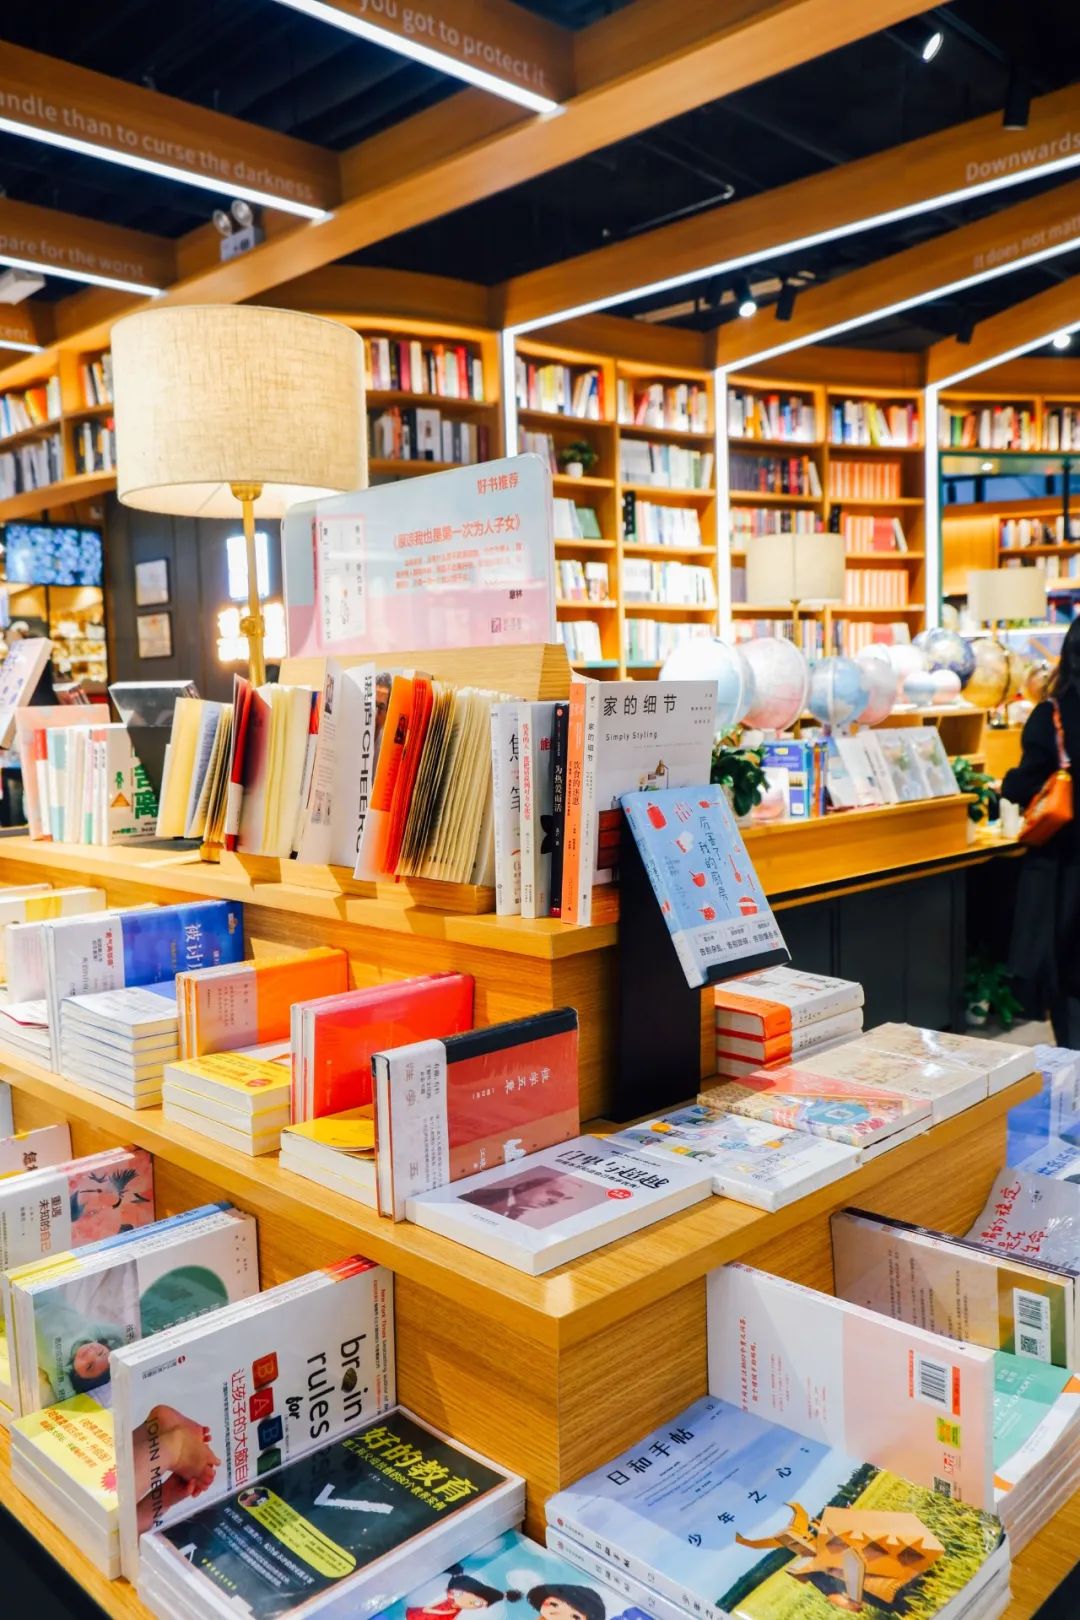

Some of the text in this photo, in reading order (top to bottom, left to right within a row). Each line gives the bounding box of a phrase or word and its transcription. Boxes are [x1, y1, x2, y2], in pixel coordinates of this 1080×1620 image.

[360, 0, 546, 87] you got to protect it
[62, 107, 112, 140] than
[116, 125, 139, 147] to
[142, 134, 197, 164] curse
[199, 151, 230, 176] the
[233, 161, 314, 201] darkness
[964, 130, 1080, 183] Downwards
[40, 239, 63, 259] for
[69, 246, 96, 266] the
[99, 257, 144, 277] worst
[986, 240, 1019, 266] does
[1021, 229, 1046, 250] not
[477, 471, 519, 495] 好书推荐
[603, 694, 677, 717] 家的细节
[605, 730, 658, 743] Simply Styling
[285, 1396, 303, 1420] for
[307, 1351, 336, 1440] rules
[144, 1418, 165, 1528] JOHN MEDINA
[355, 1426, 479, 1502] 好的教育
[607, 1427, 694, 1486] 日和手帖
[687, 1466, 792, 1547] 少年之心
